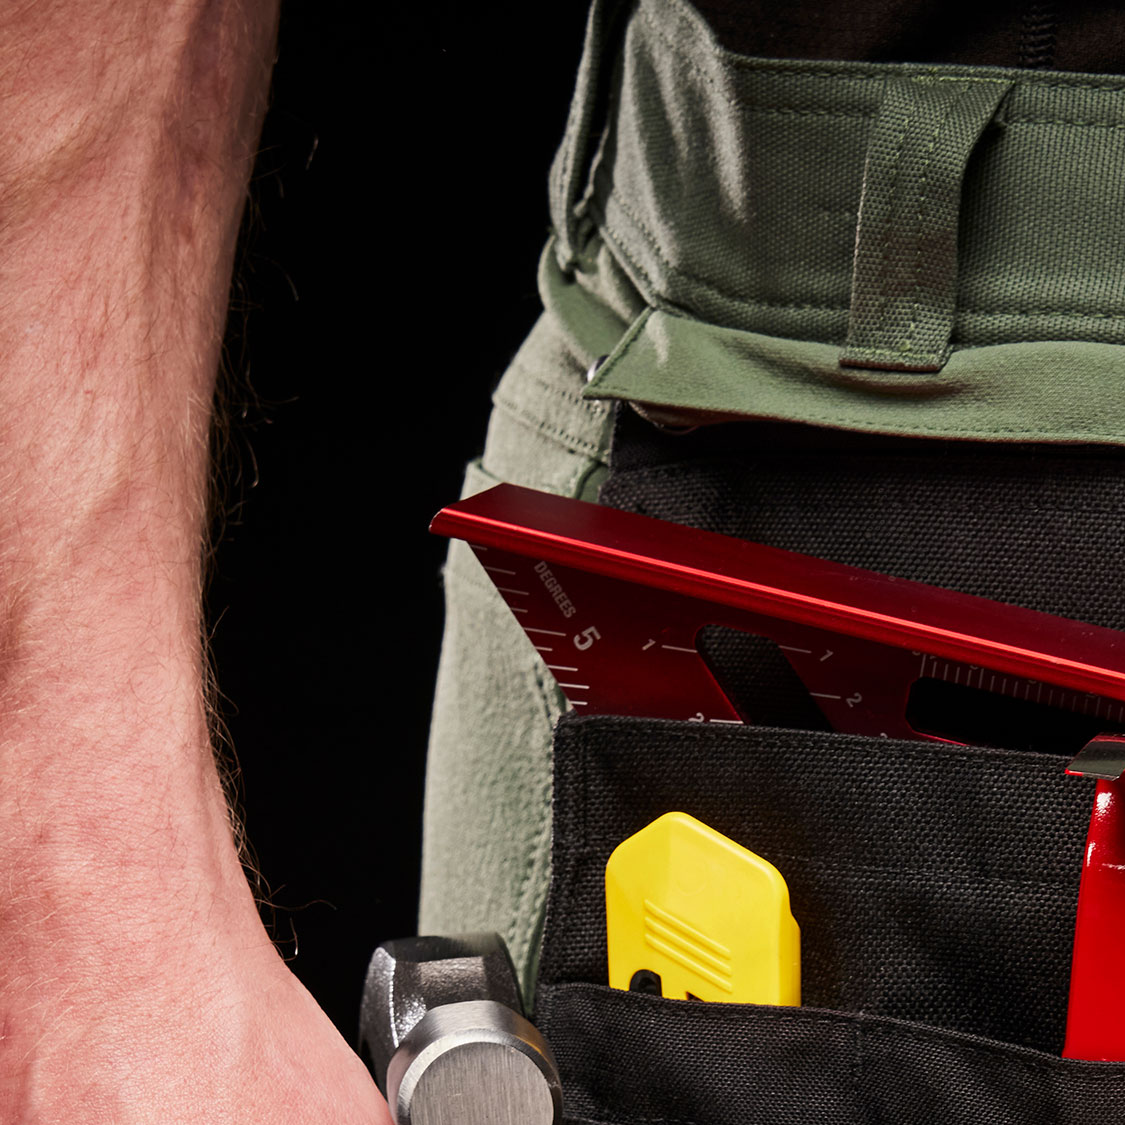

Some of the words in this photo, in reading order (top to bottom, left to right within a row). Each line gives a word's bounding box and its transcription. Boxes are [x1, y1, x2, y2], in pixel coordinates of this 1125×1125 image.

[533, 560, 577, 618] DEGREES
[572, 625, 602, 651] 5
[641, 638, 656, 651] 1
[819, 649, 834, 662] 1
[845, 691, 863, 708] 2
